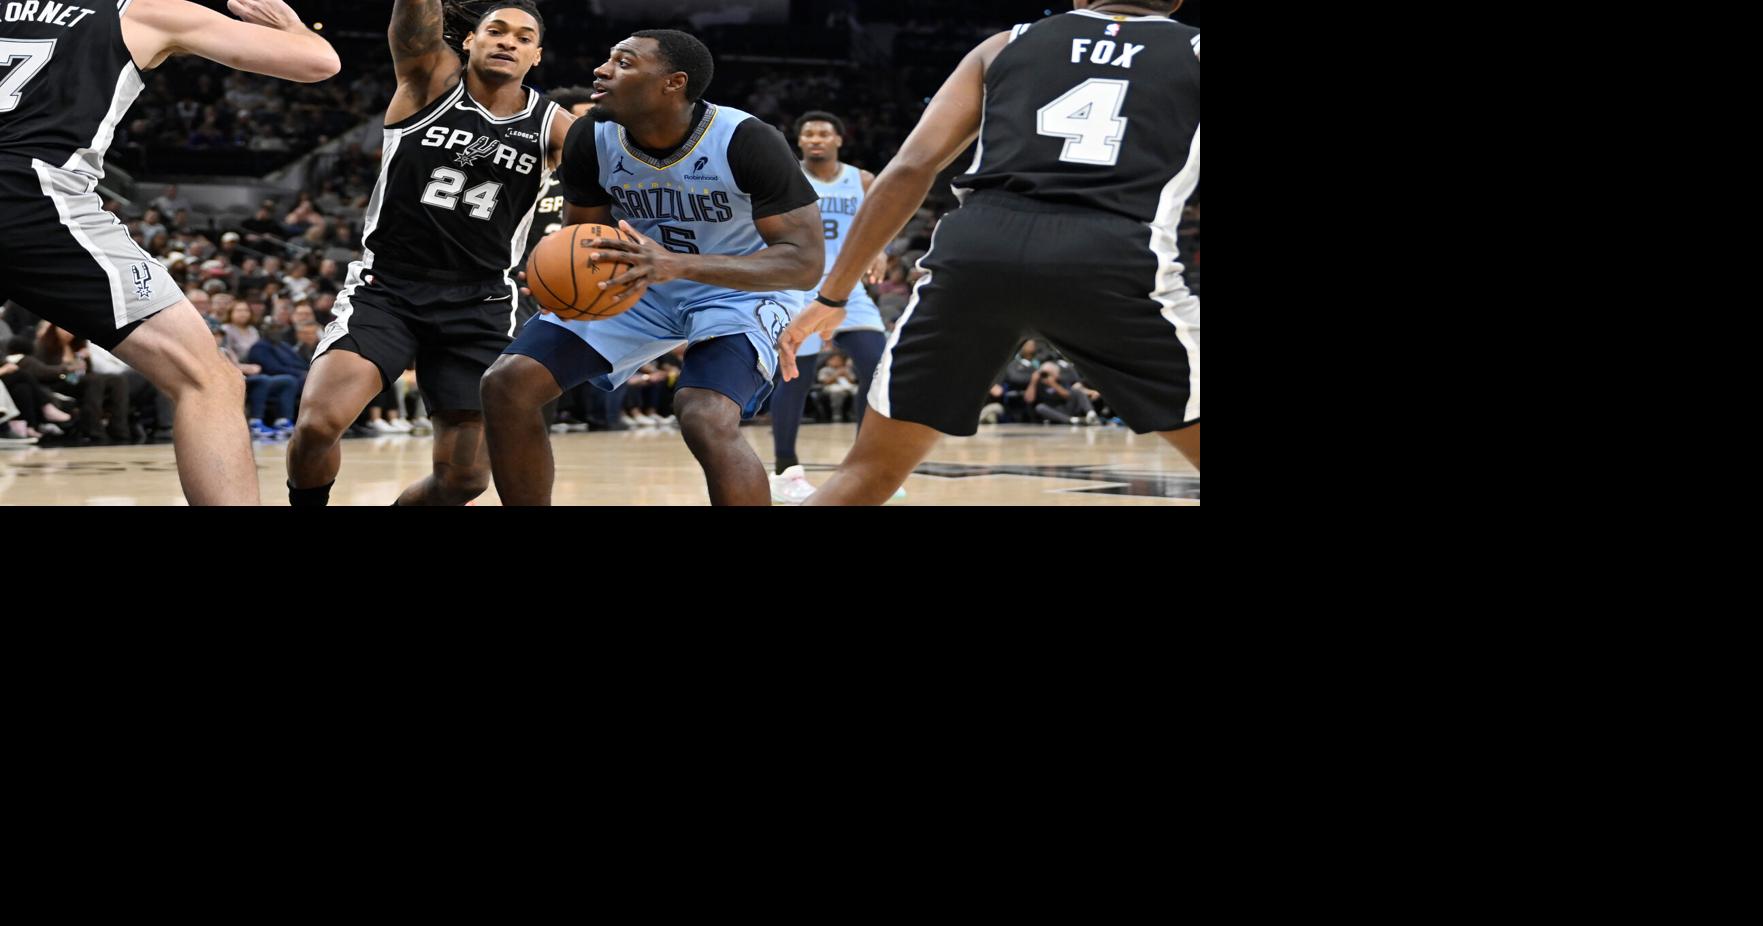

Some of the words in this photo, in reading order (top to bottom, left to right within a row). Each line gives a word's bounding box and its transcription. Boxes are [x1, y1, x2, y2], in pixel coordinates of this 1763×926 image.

[0, 0, 96, 27] ORNET
[1071, 38, 1145, 68] FOX
[0, 37, 58, 112] 7
[508, 130, 535, 140] LEDGER
[1036, 78, 1129, 165] 4
[420, 166, 503, 221] 24
[610, 185, 733, 223] GRIZZLIES
[657, 224, 700, 255] 5
